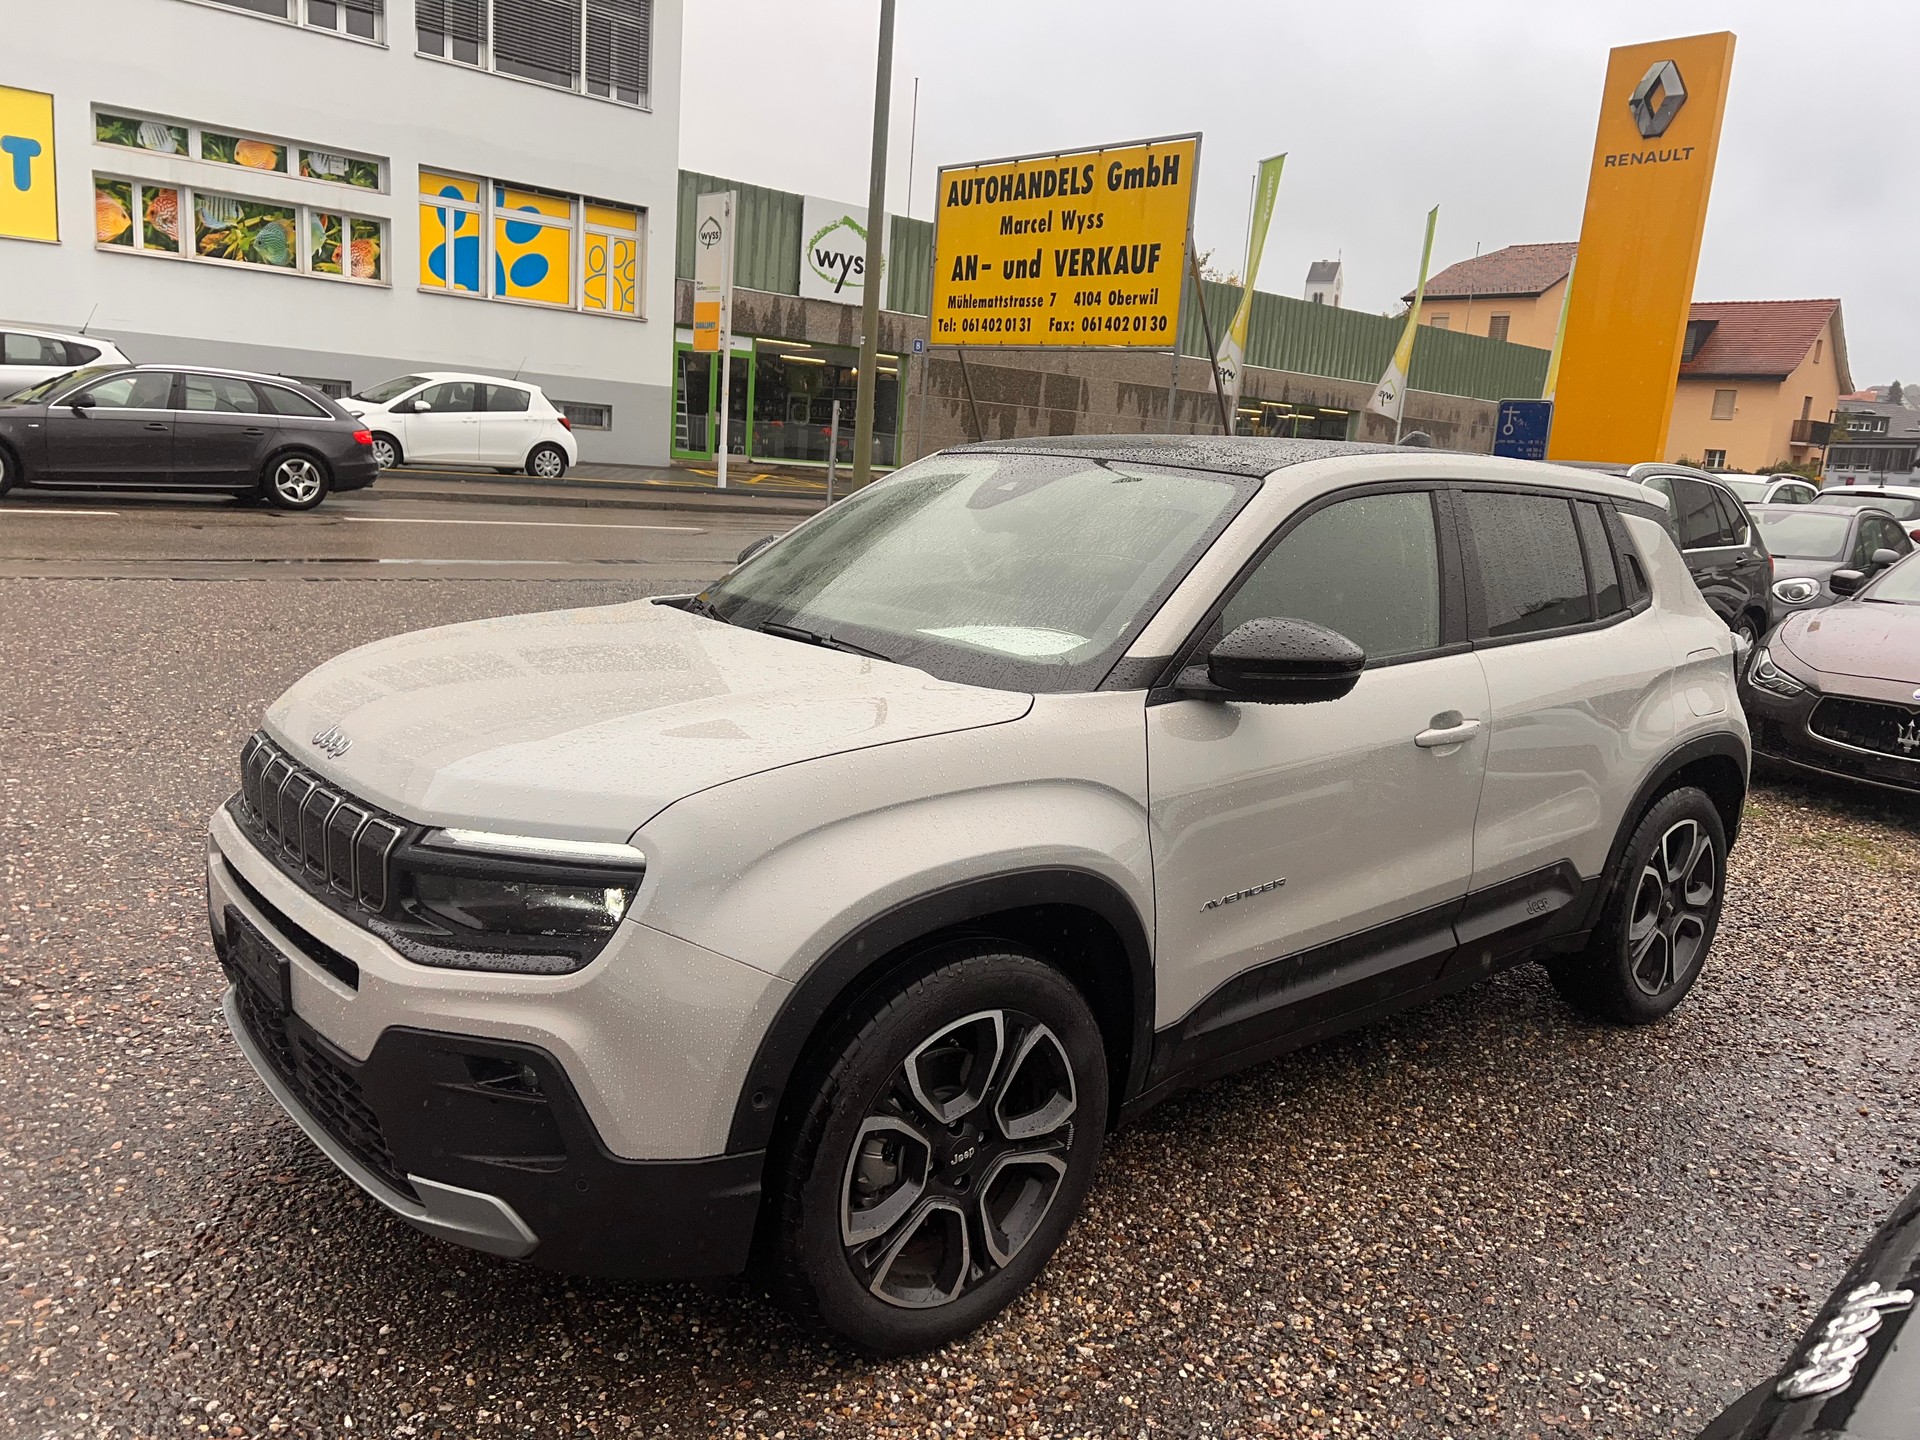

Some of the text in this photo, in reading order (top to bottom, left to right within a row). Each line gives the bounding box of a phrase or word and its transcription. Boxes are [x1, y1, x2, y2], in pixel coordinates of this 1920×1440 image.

[1, 135, 42, 192] T
[1604, 147, 1695, 167] RENAULT
[946, 154, 1180, 207] AUTOHANDELS GmbH
[1000, 210, 1104, 235] Marcel Wyss
[701, 231, 719, 250] wyss
[815, 249, 866, 294] wys
[1003, 248, 1042, 280] und
[1054, 243, 1162, 277] VERKAUF
[947, 288, 1159, 309] Mühlemattstrasse 7 4104 Oberwil
[938, 317, 957, 332] Tel:
[1049, 317, 1075, 332] Fax:
[312, 724, 353, 759] Jeep
[1200, 877, 1286, 912] AVENGER
[1526, 897, 1550, 915] Jeep
[950, 1146, 975, 1165] Jeep
